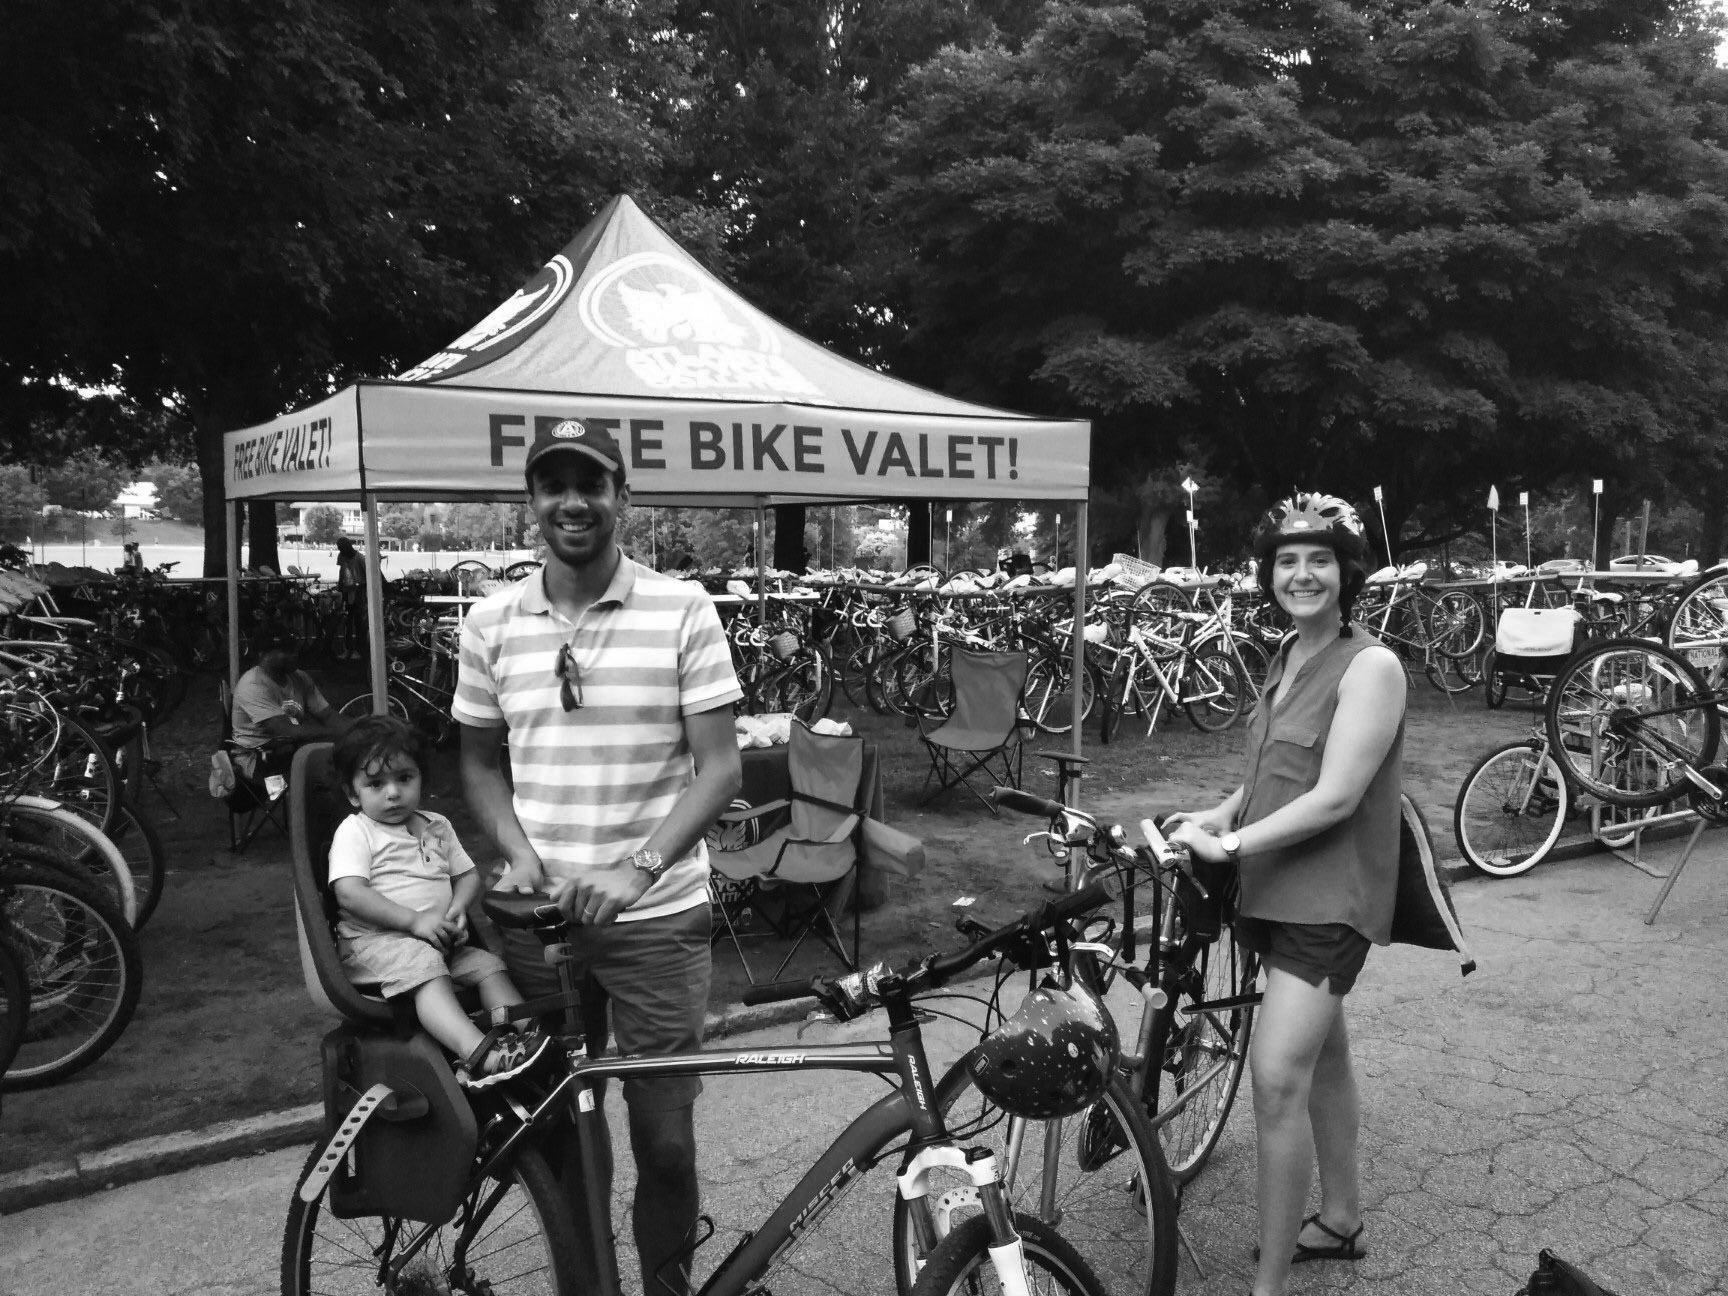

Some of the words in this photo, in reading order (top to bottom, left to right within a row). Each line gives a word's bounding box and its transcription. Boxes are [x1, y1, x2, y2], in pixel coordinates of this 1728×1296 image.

[233, 439, 256, 482] FREE
[255, 430, 283, 476] BIKE
[281, 416, 332, 472] VALET!
[489, 414, 666, 469] FE
[690, 421, 824, 473] BIKE
[841, 429, 1018, 480] VALET!
[735, 1053, 806, 1064] RALEIGH
[907, 1054, 927, 1110] RALEIGH
